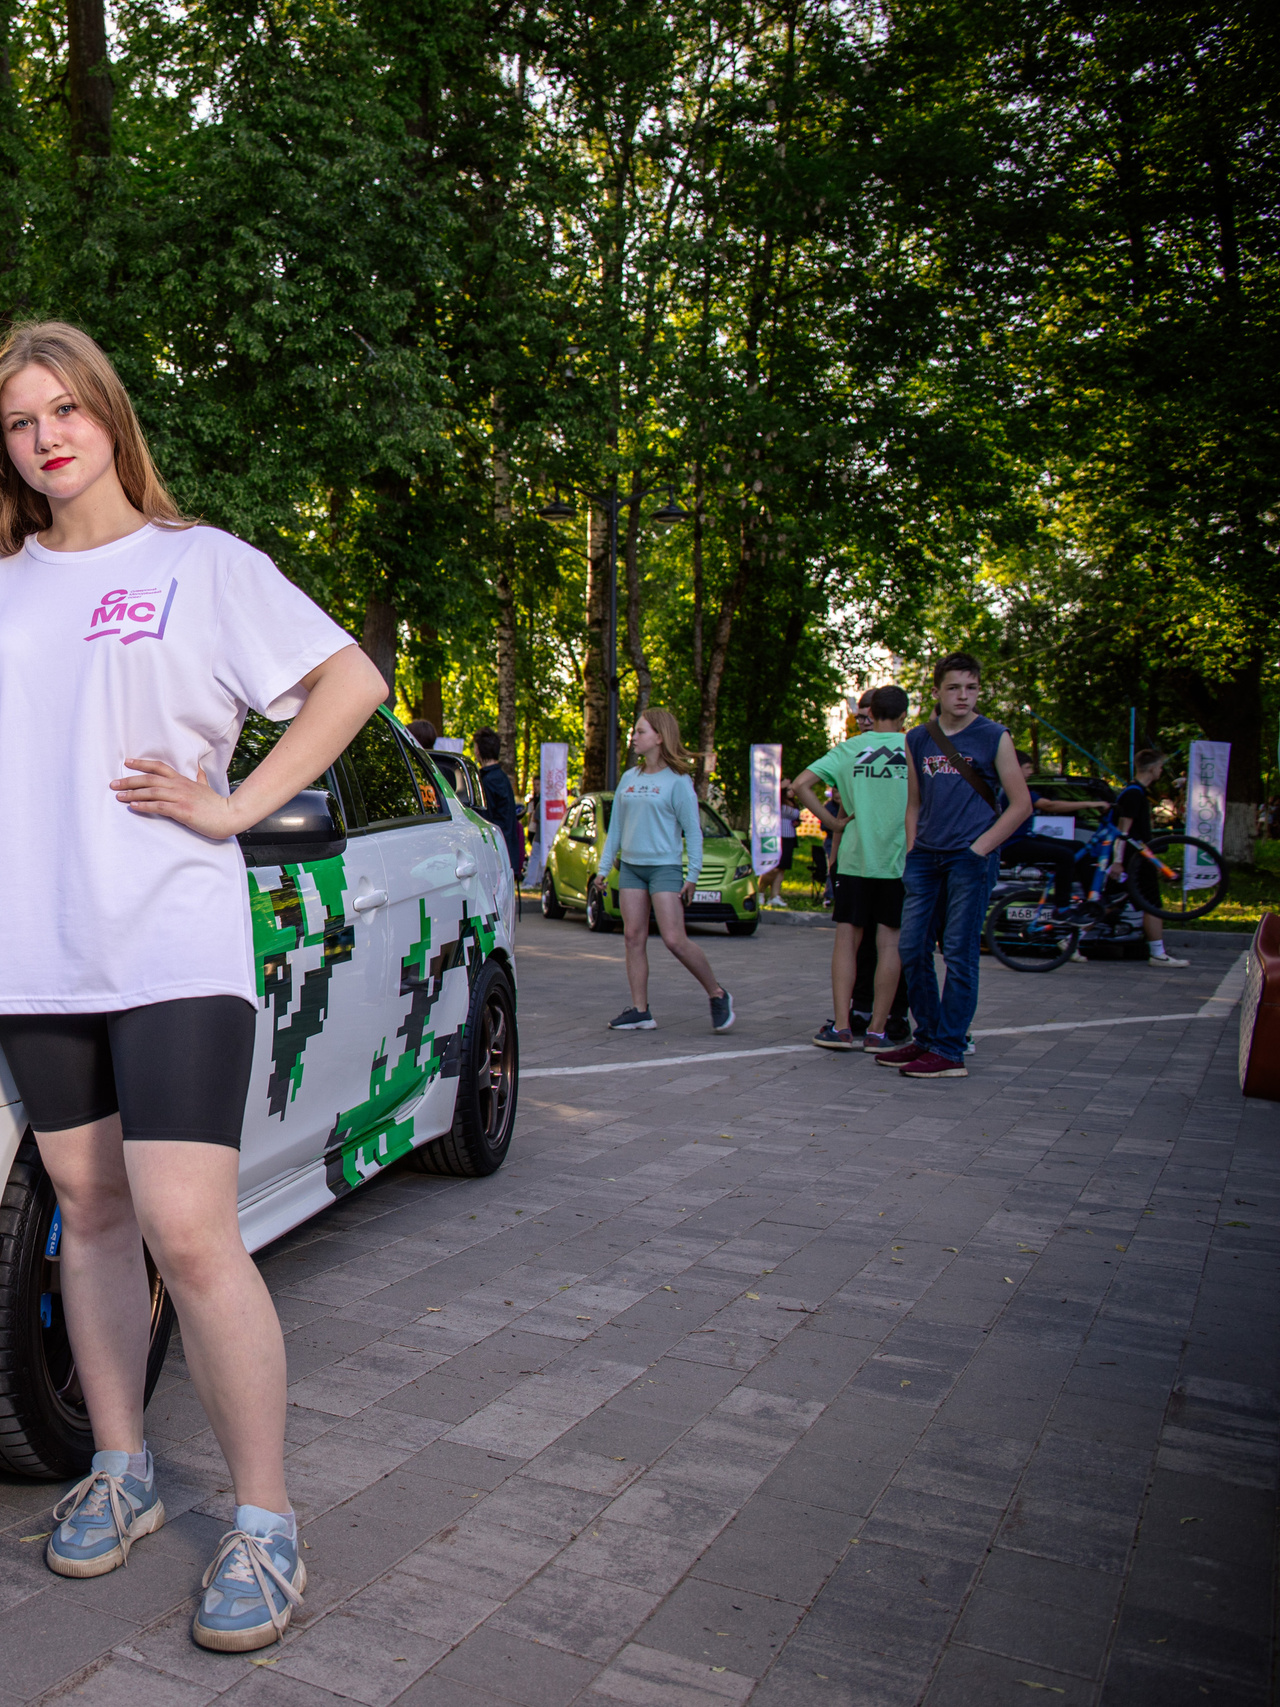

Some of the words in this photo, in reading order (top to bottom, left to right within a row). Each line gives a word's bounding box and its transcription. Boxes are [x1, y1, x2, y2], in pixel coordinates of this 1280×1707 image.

[101, 589, 128, 605] С
[90, 602, 156, 628] МС
[760, 758, 771, 784] FEST
[853, 766, 892, 779] FILA
[1200, 753, 1215, 787] FEST
[760, 791, 772, 835] BOOST
[1198, 792, 1214, 844] BOOST
[50, 1223, 59, 1255] mbo
